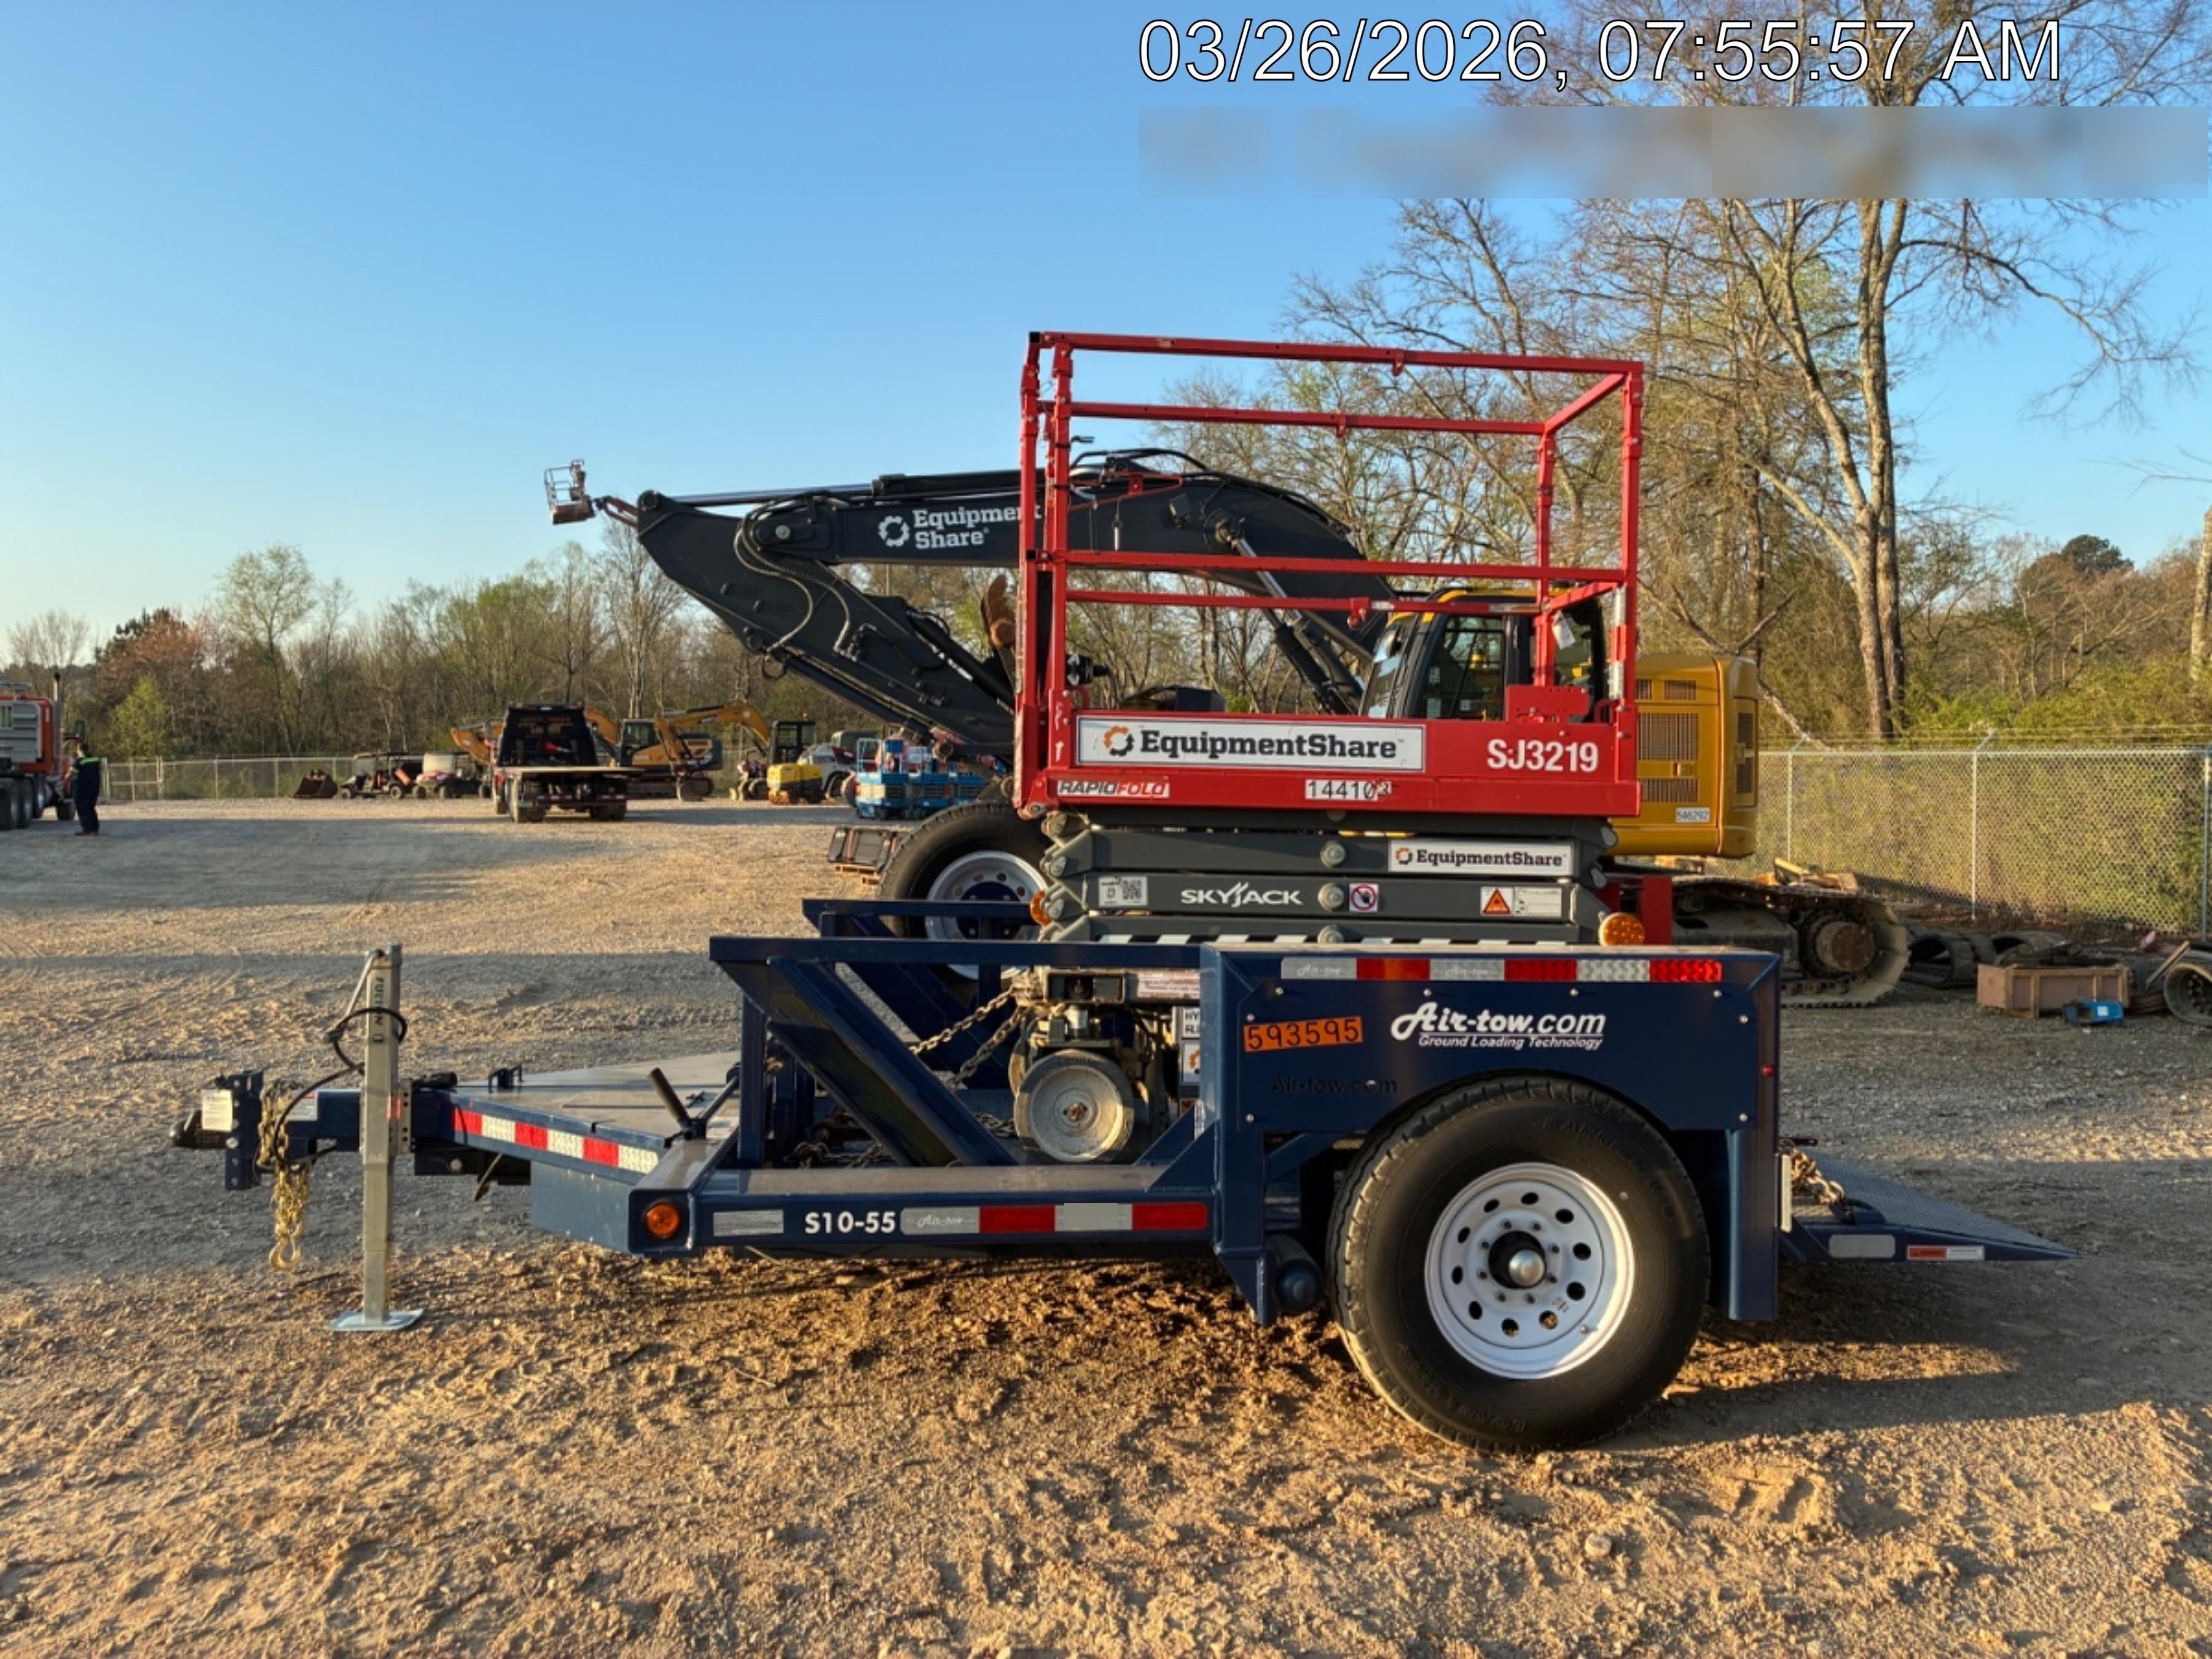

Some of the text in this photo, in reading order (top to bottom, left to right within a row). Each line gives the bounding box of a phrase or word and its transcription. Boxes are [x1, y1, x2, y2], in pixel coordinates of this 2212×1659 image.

[915, 530, 984, 549] Share
[1140, 730, 1396, 759] EquipmentShare
[1487, 739, 1599, 773] SJ3219
[1417, 850, 1563, 867] EquipmentShare
[1181, 881, 1304, 908] SKYJACK
[1249, 1019, 1360, 1049] 593595
[1390, 1002, 1607, 1040] Air-tow.com
[1419, 1035, 1602, 1051] Ground Loading Technology
[805, 1211, 896, 1234] S10-55
